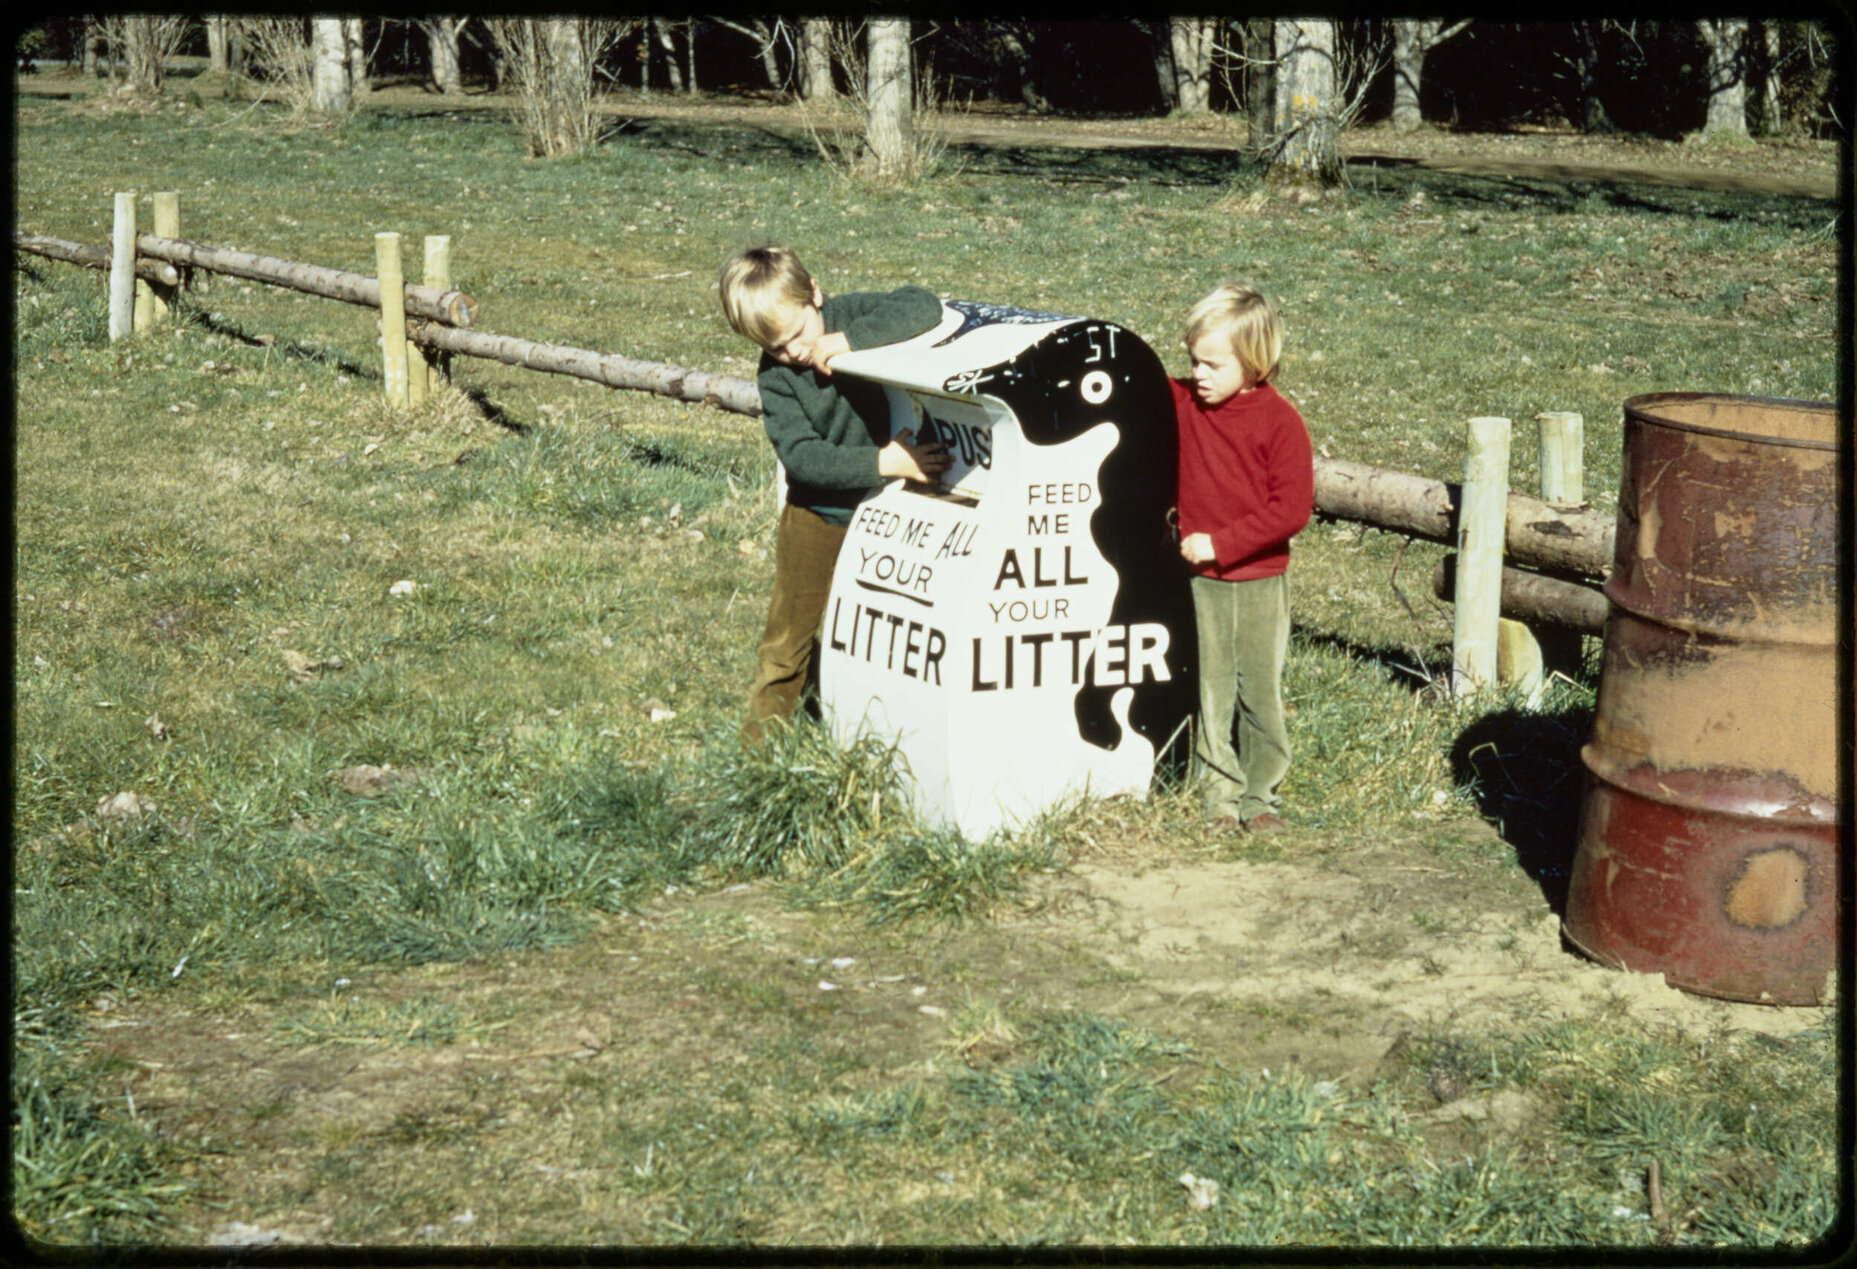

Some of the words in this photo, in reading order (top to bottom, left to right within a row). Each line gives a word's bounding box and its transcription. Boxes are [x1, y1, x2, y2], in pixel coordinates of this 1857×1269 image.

[935, 417, 993, 470] PUS
[1029, 483, 1091, 504] FEED
[855, 507, 898, 538] FEED
[905, 519, 933, 548] ME
[935, 521, 979, 560] ALL
[1028, 515, 1069, 534] ME
[860, 548, 933, 593] YOUR
[994, 546, 1088, 590] ALL
[989, 599, 1069, 623] YOUR
[830, 597, 946, 686] LITTER
[972, 623, 1172, 692] LITTER
